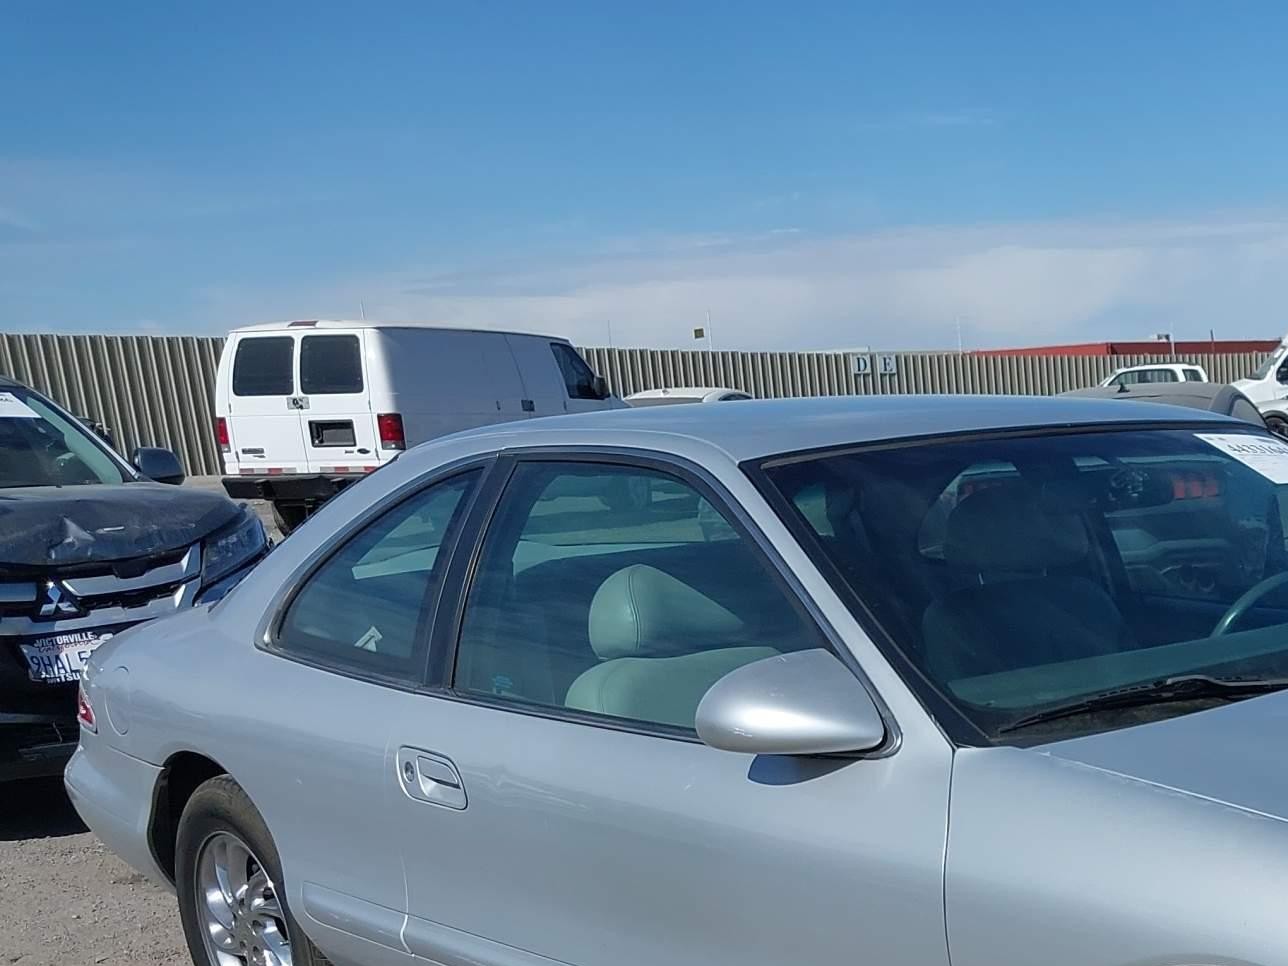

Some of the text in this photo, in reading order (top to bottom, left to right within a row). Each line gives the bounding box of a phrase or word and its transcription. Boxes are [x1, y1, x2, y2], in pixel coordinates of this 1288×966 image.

[856, 356, 894, 372] D E
[33, 631, 94, 648] VICTORVILLE
[30, 650, 93, 677] 9HAL5
